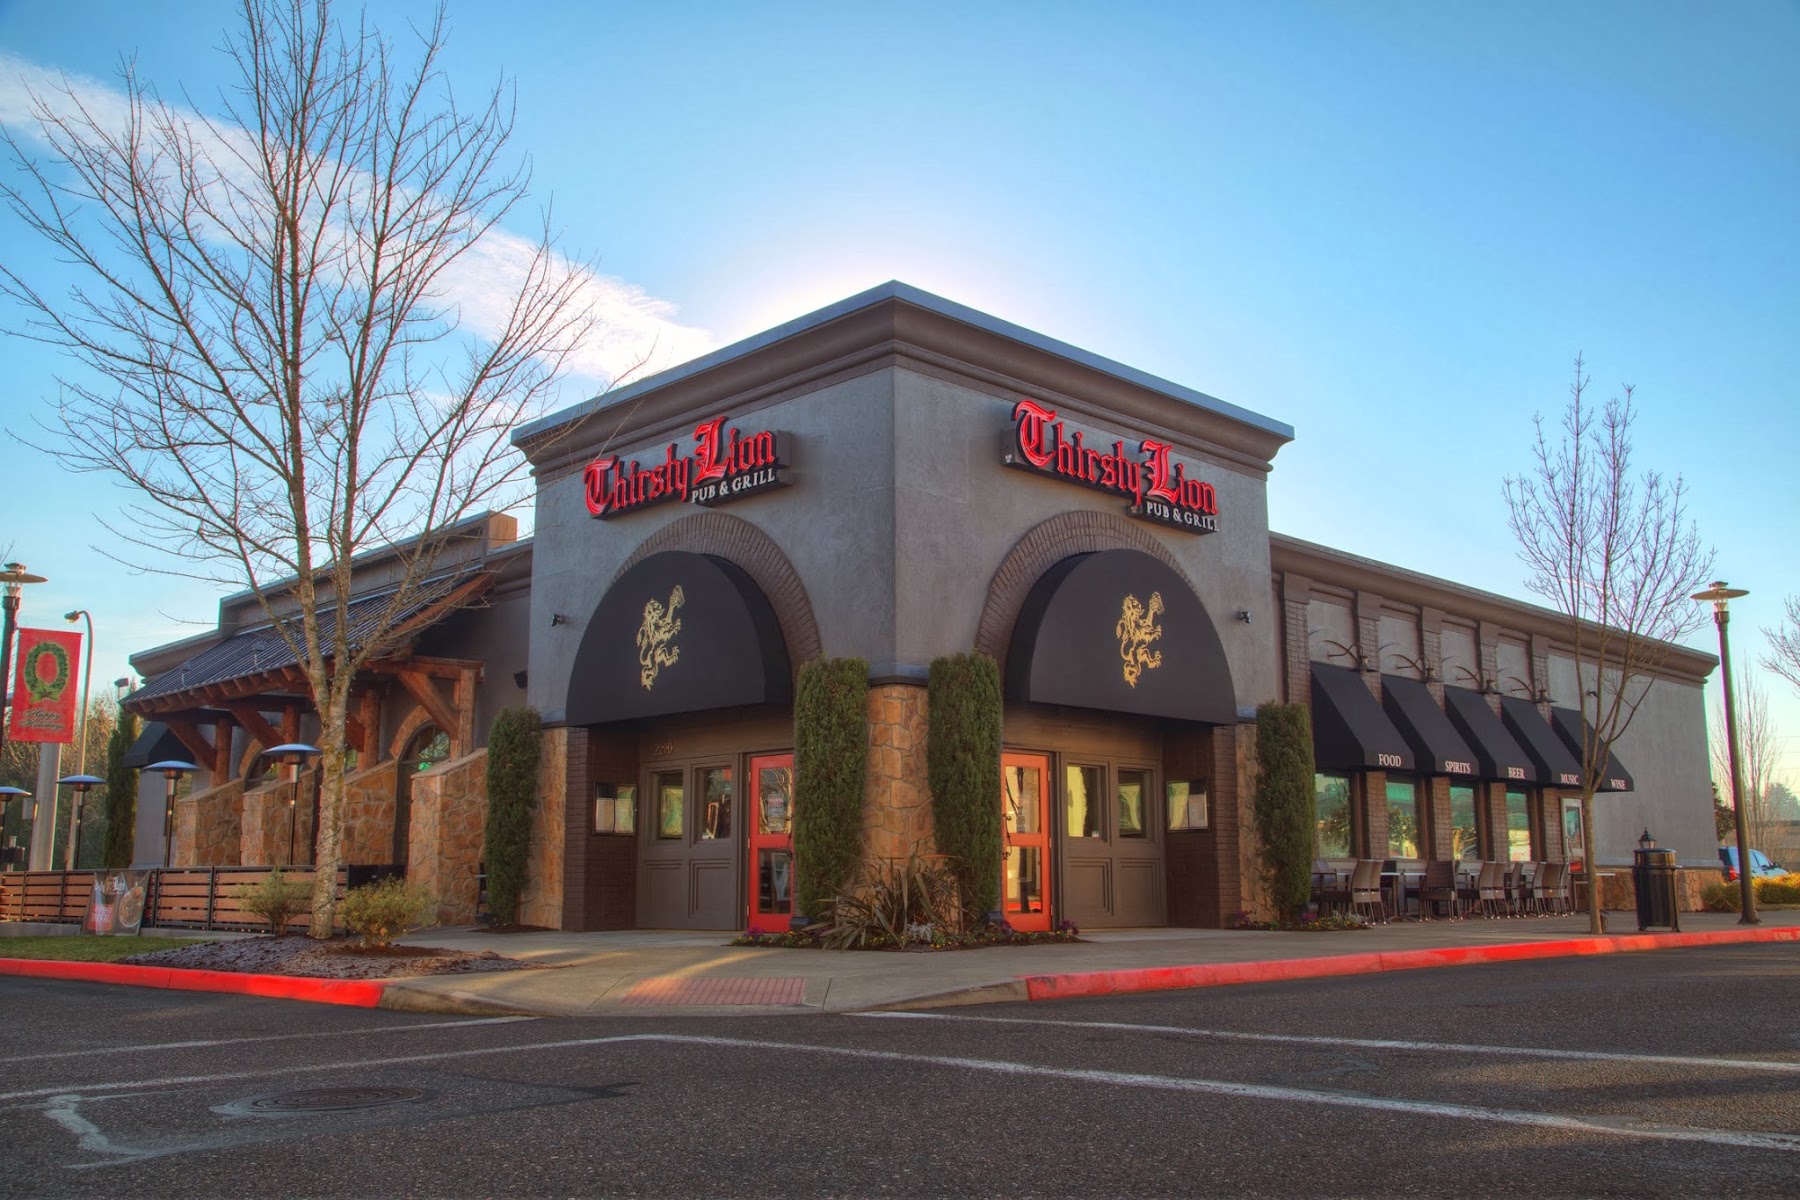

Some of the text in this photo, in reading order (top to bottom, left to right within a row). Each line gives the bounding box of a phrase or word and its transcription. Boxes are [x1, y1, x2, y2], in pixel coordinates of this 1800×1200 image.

[1014, 400, 1218, 515] Thirsty Lion
[583, 415, 776, 516] Thirsty Lion
[691, 468, 775, 504] PUB & GRILL
[1146, 501, 1220, 532] PUB & GRILL
[24, 708, 61, 721] Happy
[19, 718, 65, 730] Holidays
[1378, 754, 1401, 767] FOOD
[1445, 761, 1471, 774] SPIRITS
[1508, 767, 1525, 779] BEER
[1560, 773, 1579, 785] MUSIC
[1610, 778, 1626, 789] WINE
